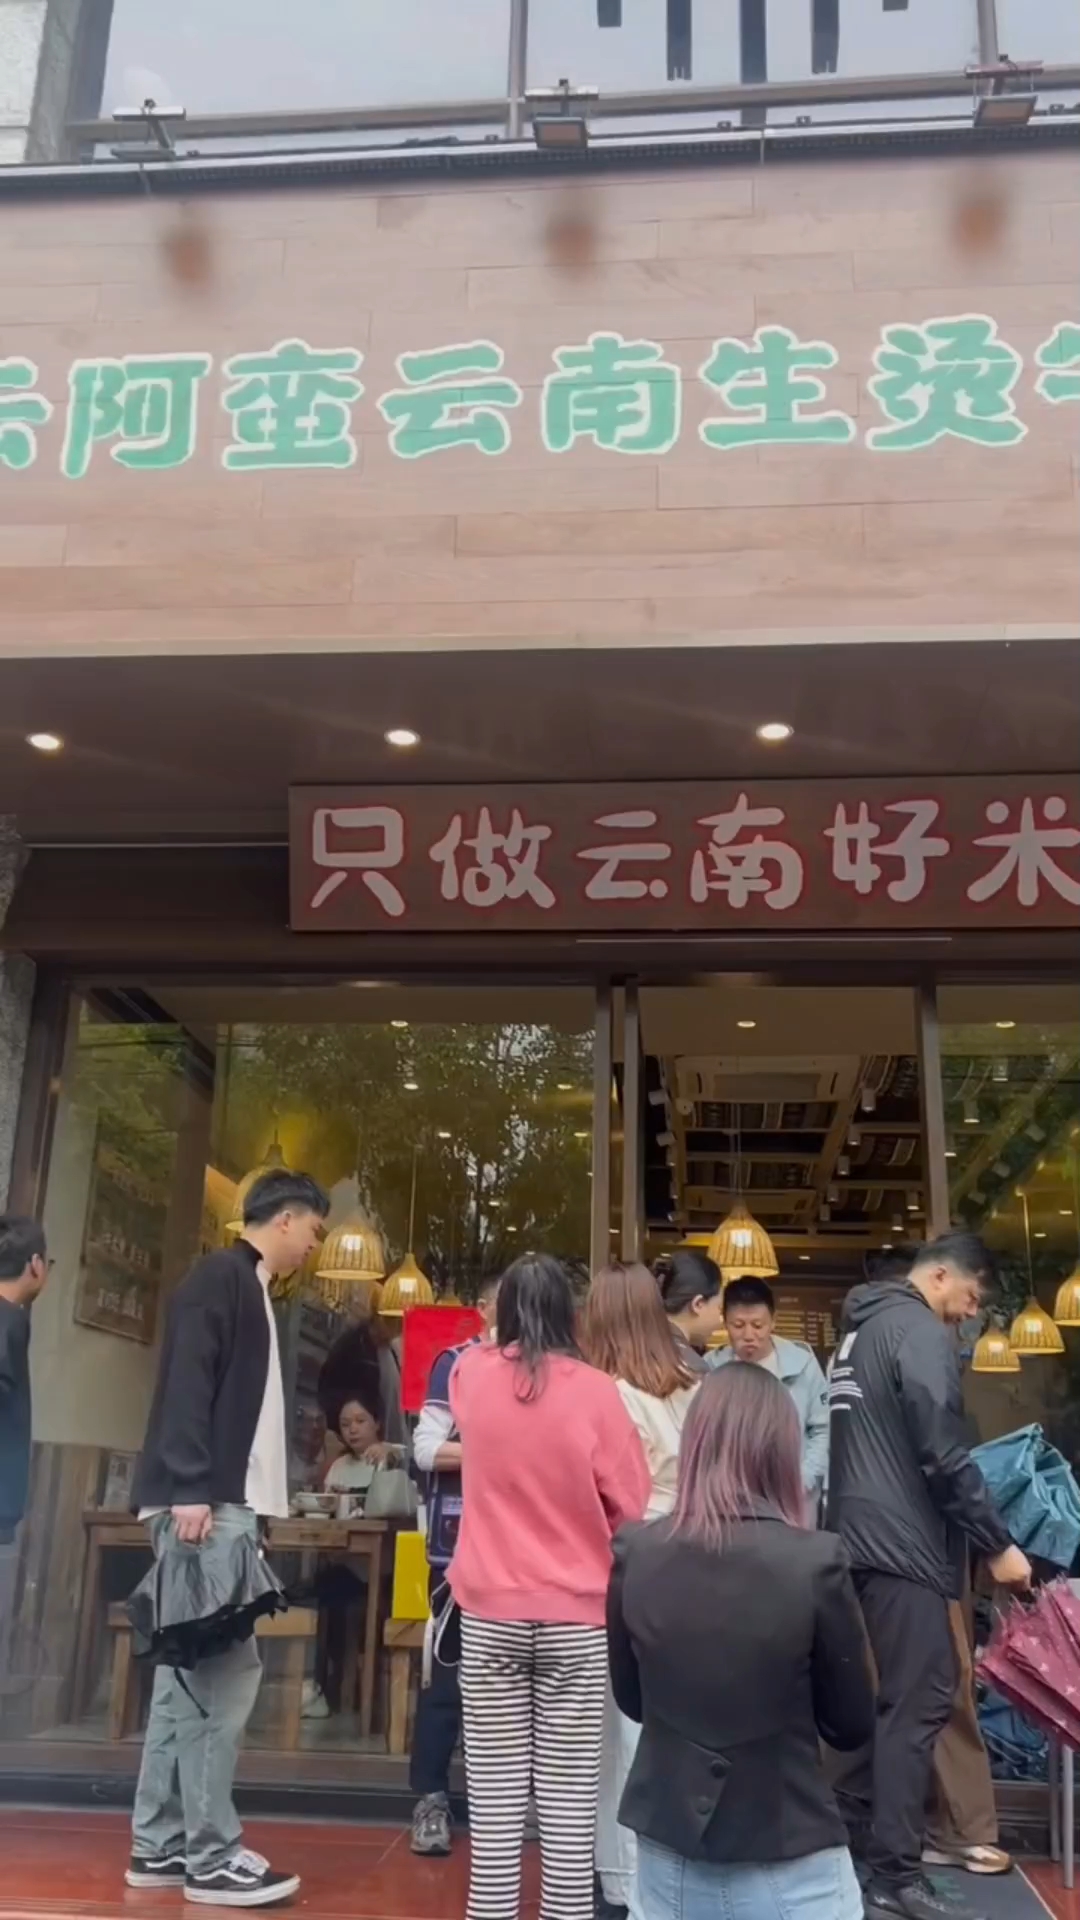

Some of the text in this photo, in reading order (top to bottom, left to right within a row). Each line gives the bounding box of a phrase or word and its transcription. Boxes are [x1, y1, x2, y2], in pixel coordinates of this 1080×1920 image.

[310, 793, 1080, 917] 只做云南好米
